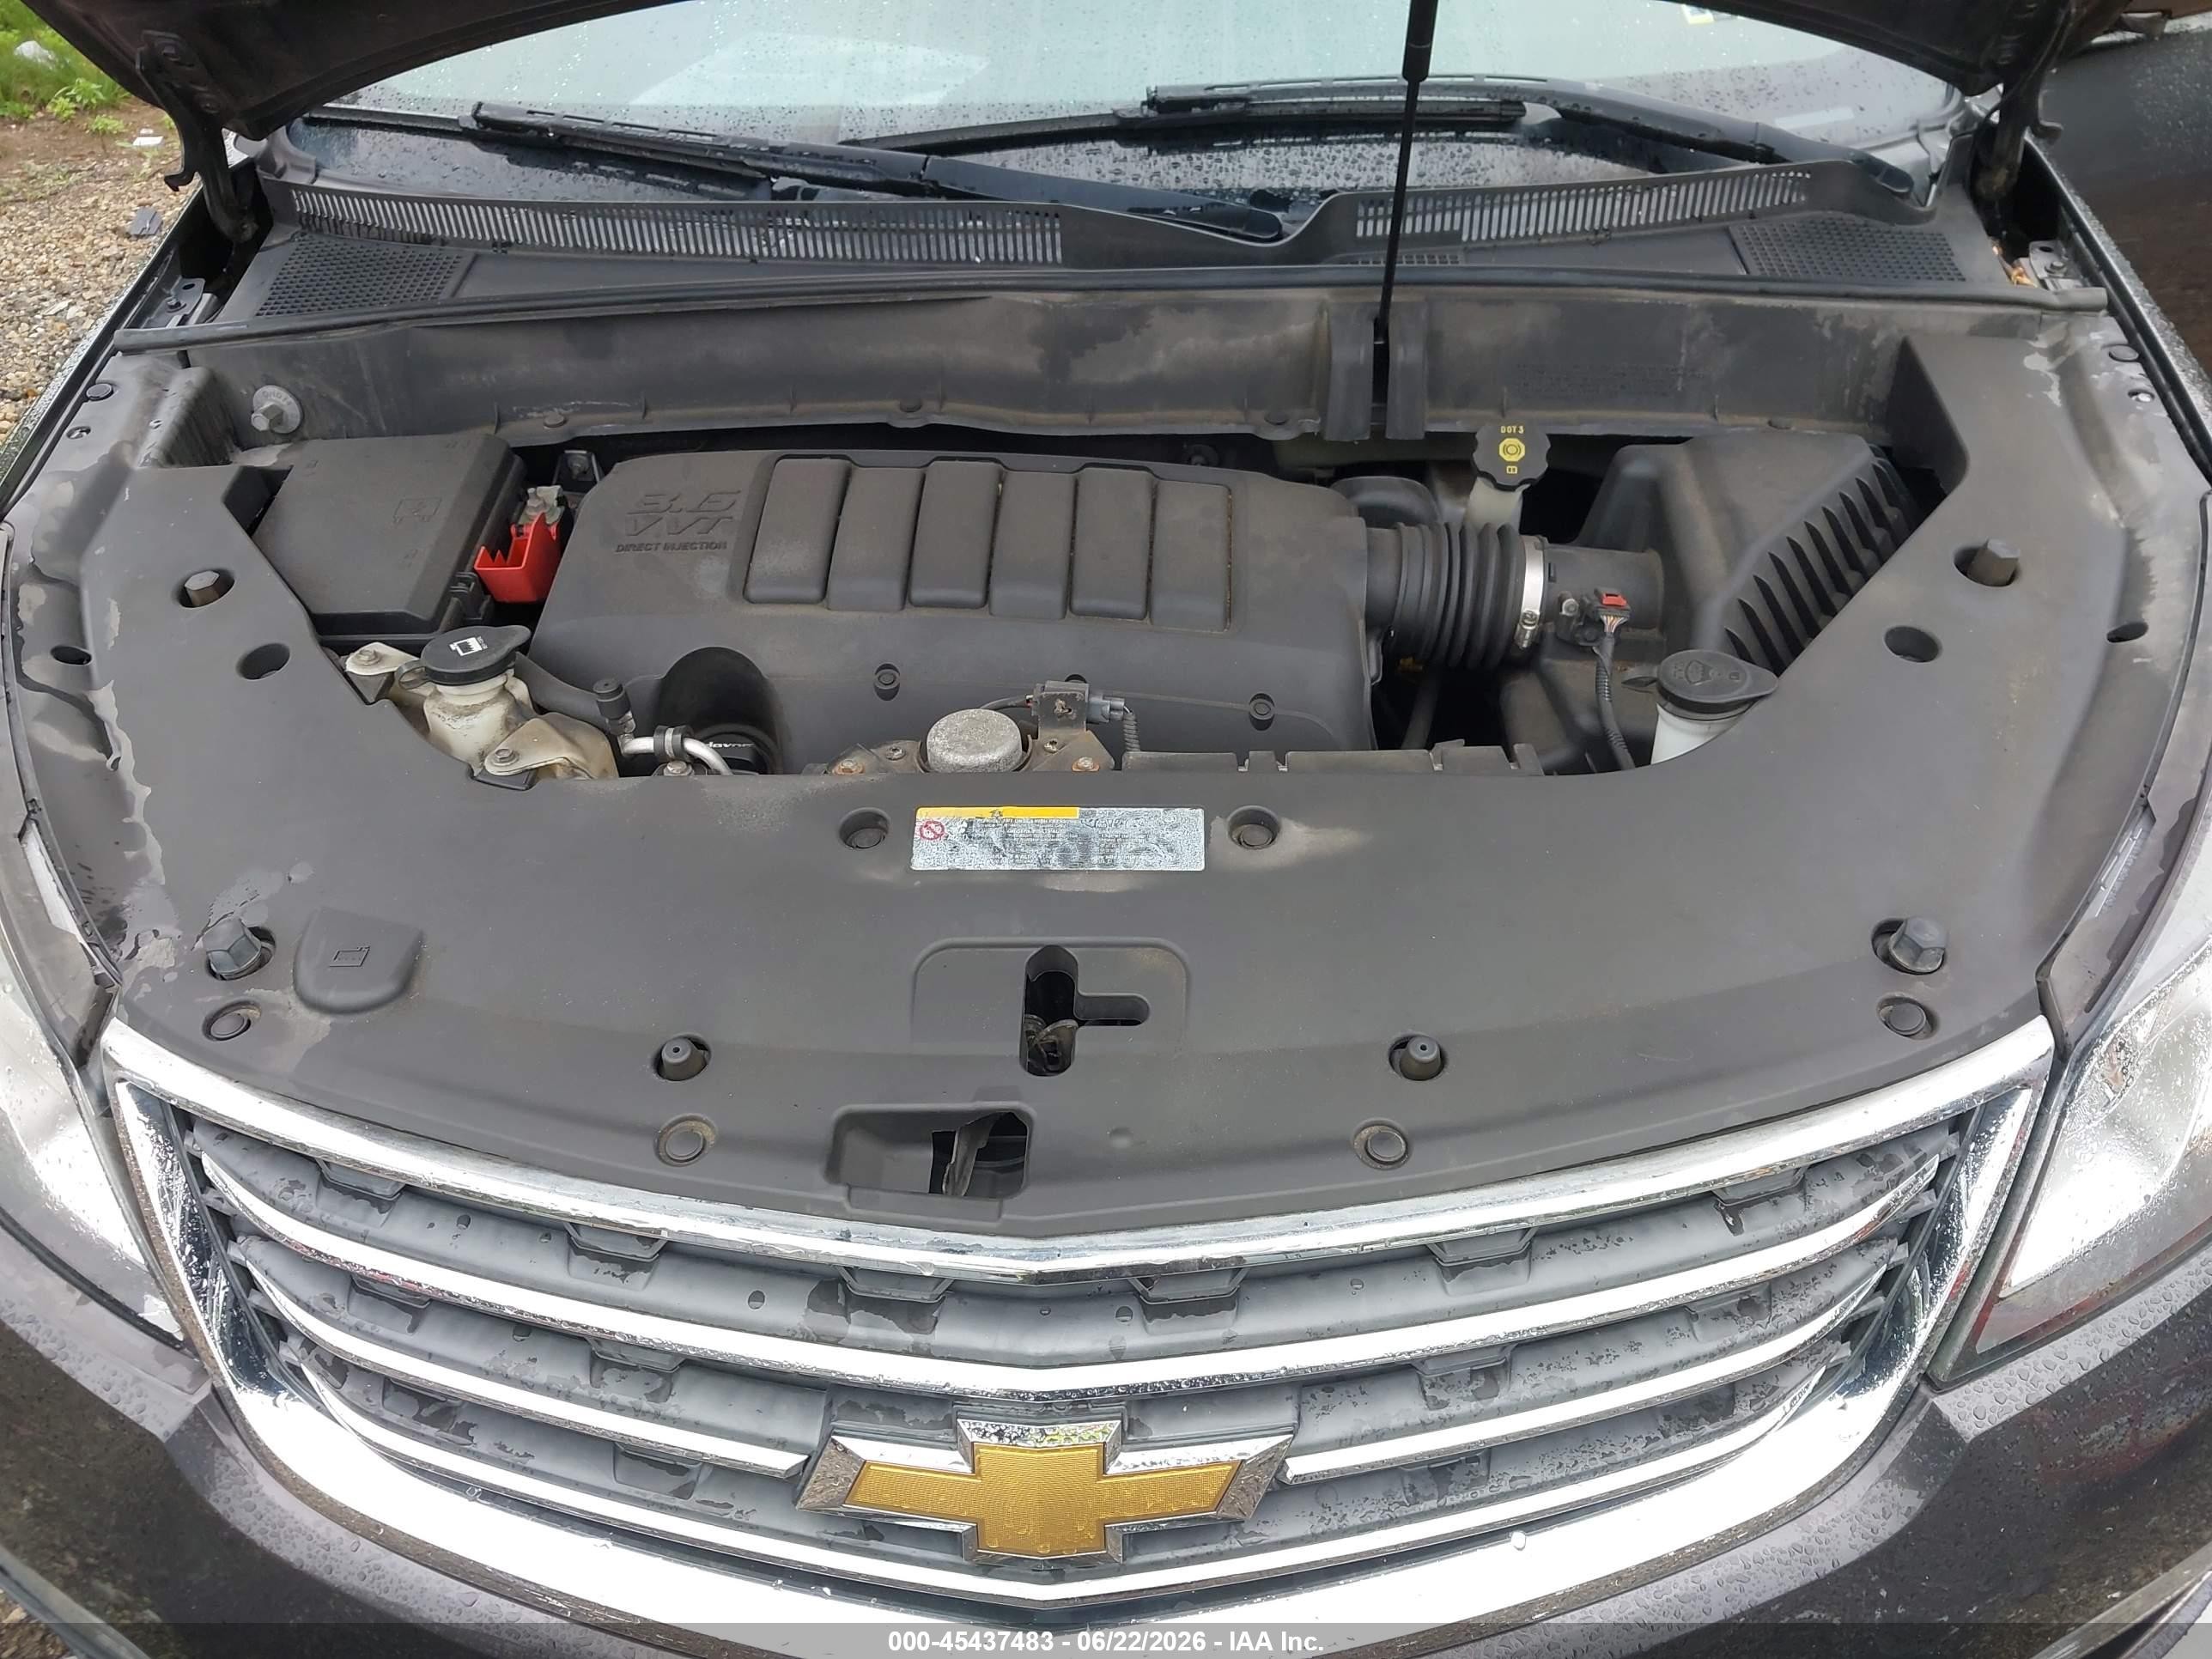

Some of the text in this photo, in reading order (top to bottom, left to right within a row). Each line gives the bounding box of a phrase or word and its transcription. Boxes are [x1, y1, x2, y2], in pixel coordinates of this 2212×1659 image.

[626, 489, 742, 515] 3.6
[625, 516, 733, 537] VVT
[615, 540, 728, 553] DIRECT INJECTION
